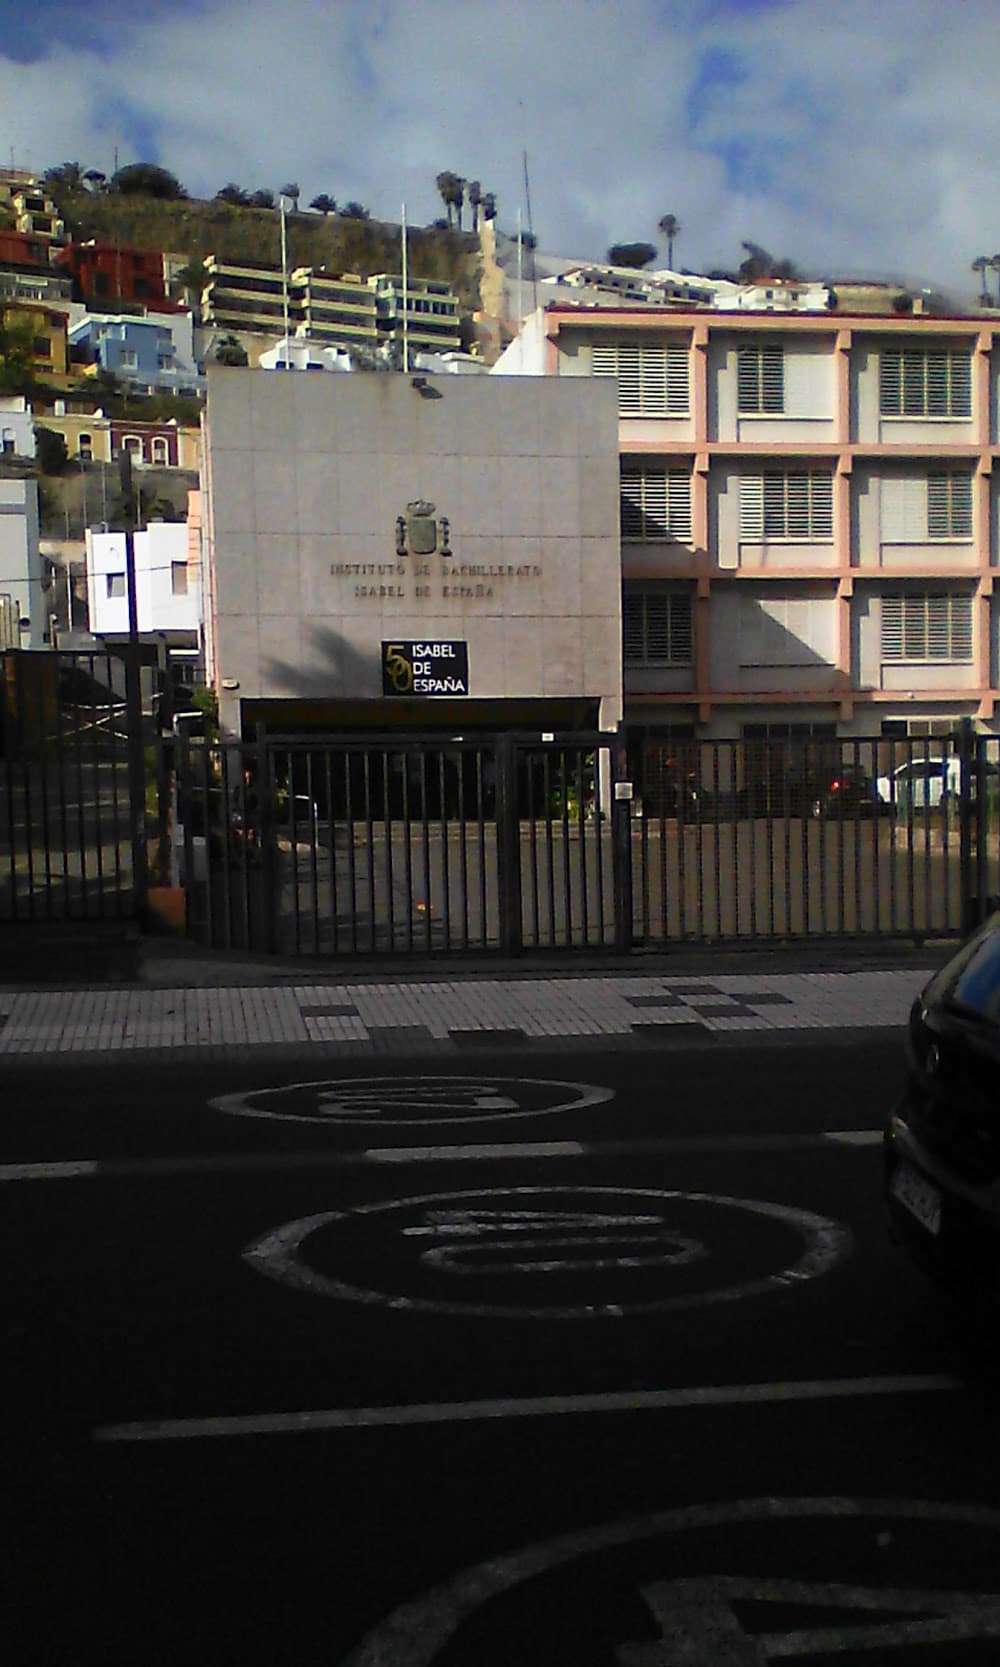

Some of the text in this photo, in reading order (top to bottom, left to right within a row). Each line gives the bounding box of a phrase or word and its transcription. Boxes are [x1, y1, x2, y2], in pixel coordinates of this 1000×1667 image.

[330, 564, 542, 577] INSTITUTO DE BACHILLERATO
[355, 583, 494, 598] ISABEL DE ESPAÑA
[412, 644, 456, 657] ISABEL
[385, 645, 412, 691] 50
[412, 661, 431, 675] DE
[413, 676, 466, 692] ESPAÑA
